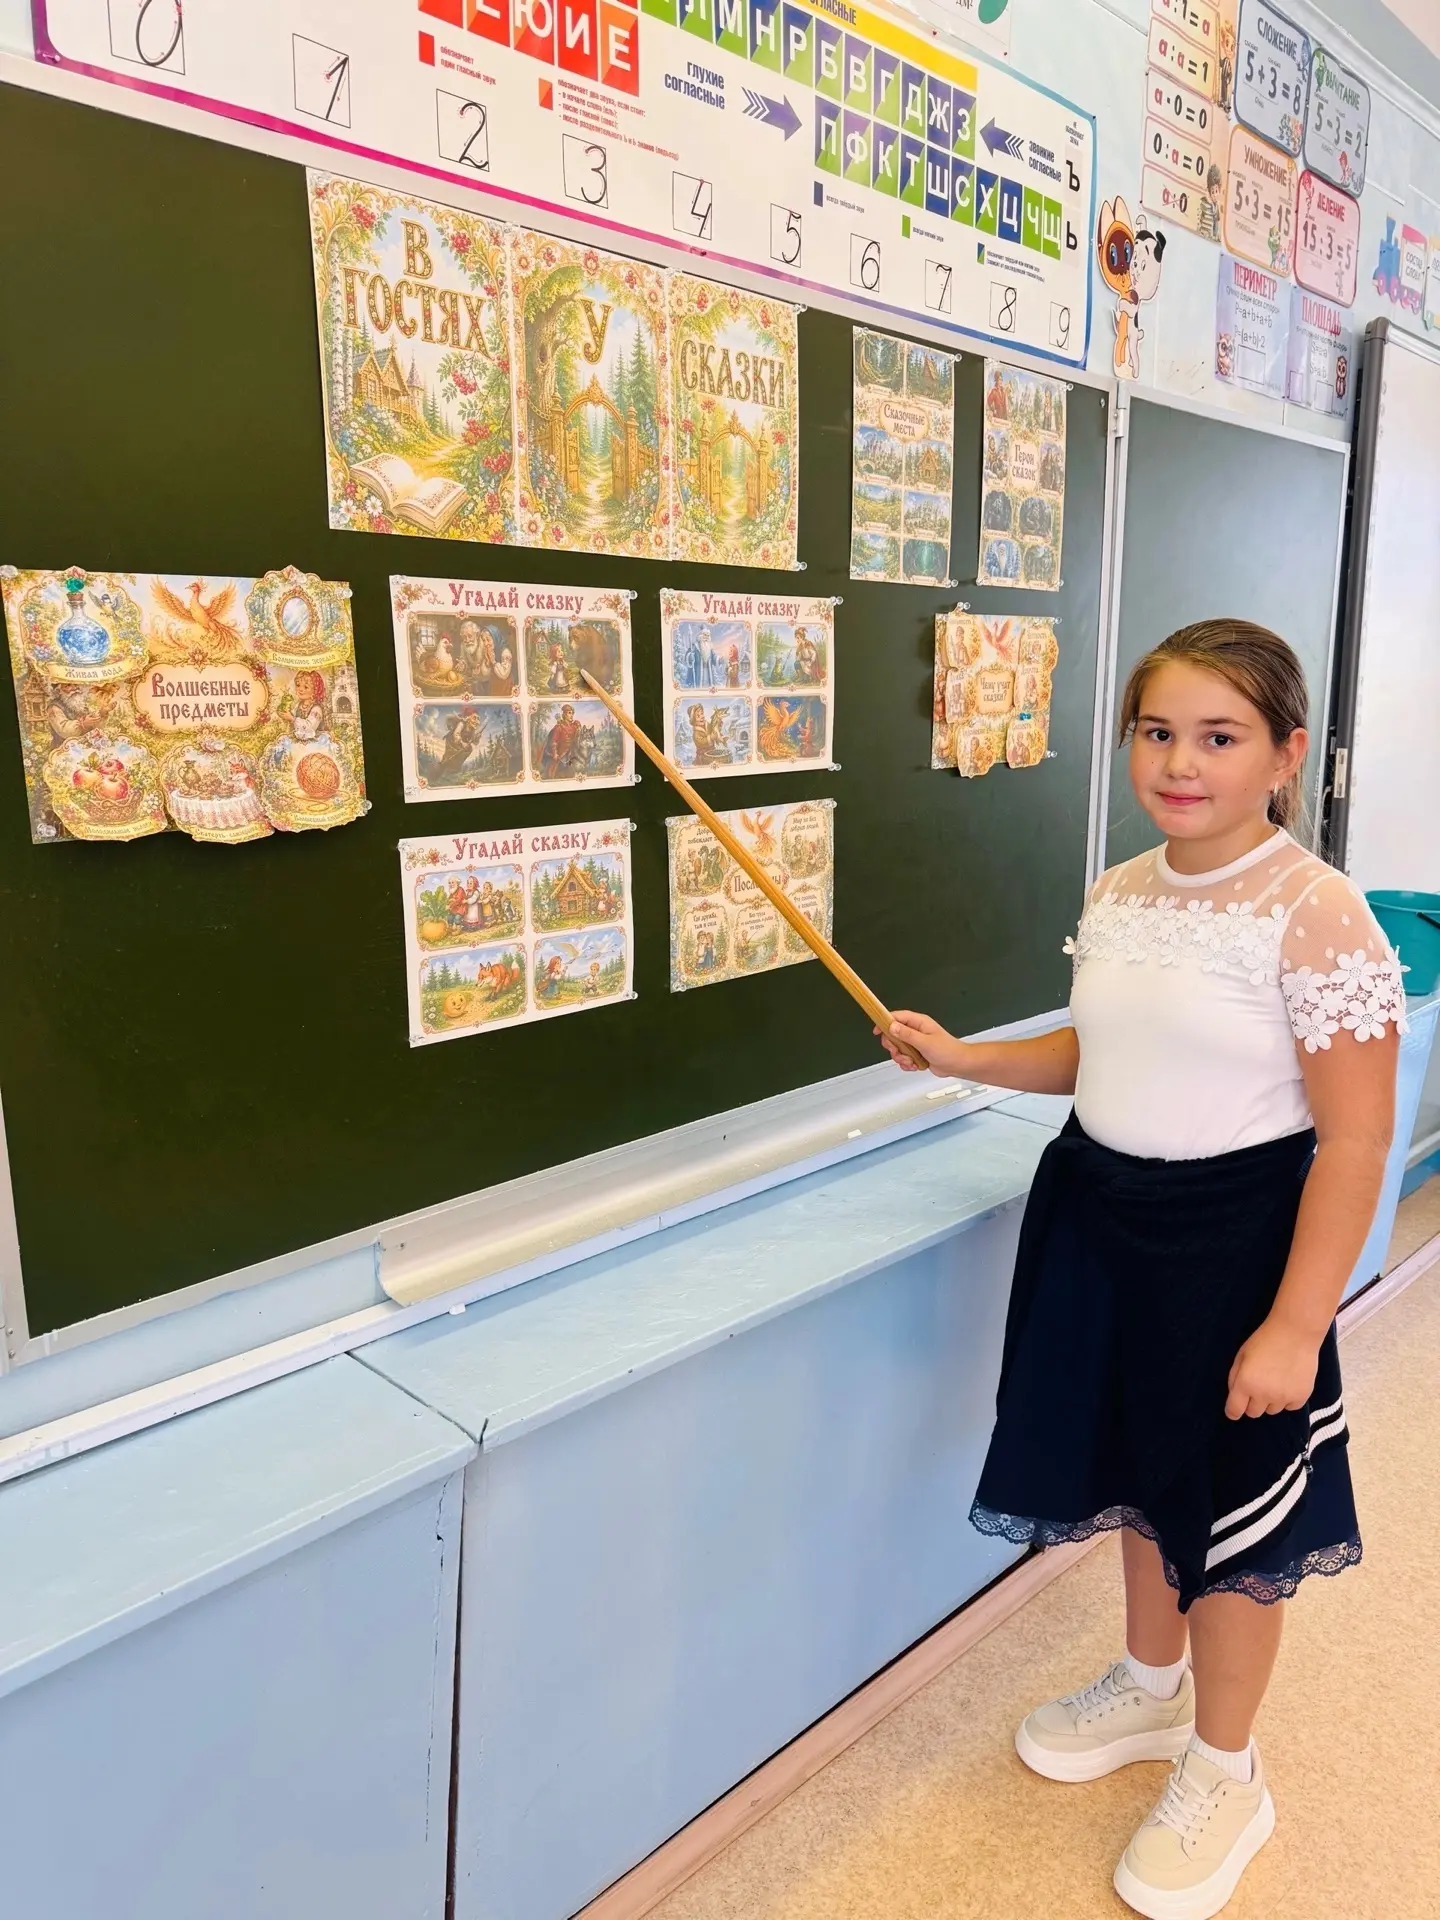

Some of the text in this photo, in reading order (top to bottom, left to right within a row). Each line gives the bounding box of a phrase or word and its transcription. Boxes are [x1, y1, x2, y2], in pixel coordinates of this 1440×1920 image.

[136, 0, 183, 66] 0
[810, 0, 856, 26] ЛАСНЫЕ
[515, 0, 552, 38] Ю
[565, 6, 591, 56] И
[609, 24, 631, 71] Е
[1257, 17, 1298, 61] СЛОЖЕНИЕ
[325, 55, 349, 120] 1
[664, 73, 725, 110] согласные
[687, 61, 724, 90] глухие
[719, 0, 743, 38] М
[756, 8, 775, 52] Н
[789, 24, 807, 62] Р
[821, 40, 838, 80] Б
[850, 54, 867, 93] В
[881, 69, 894, 103] Г
[905, 82, 923, 127] Д
[929, 94, 950, 133] Ж
[957, 108, 971, 141] З
[1203, 62, 1208, 83] 1
[1245, 50, 1255, 82] 5
[1268, 66, 1277, 98] 3
[1293, 84, 1301, 115] 8
[1325, 68, 1360, 111] ВЫЧИТАНИЕ
[459, 102, 488, 168] 2
[1315, 101, 1324, 131] 5
[1334, 116, 1341, 145] 3
[1355, 131, 1362, 159] 2
[1028, 156, 1061, 183] согласные
[1029, 141, 1055, 163] звонкие
[1244, 144, 1287, 187] УМНОЖЕНИЕ
[582, 145, 608, 204] 3
[821, 115, 1061, 251] П Ф К Т Ш С Х Ц Ч Щ
[1065, 159, 1080, 192] Ъ
[691, 180, 712, 237] 4
[1234, 180, 1243, 211] 5
[1251, 189, 1259, 220] 3
[1277, 204, 1291, 237] 15
[1317, 191, 1345, 222] ДЕЛЕНИЕ
[401, 218, 432, 279] В
[782, 211, 801, 263] 5
[1066, 220, 1078, 251] Ь
[1303, 221, 1317, 251] 15
[1326, 232, 1333, 260] 3
[861, 241, 880, 290] 6
[1234, 262, 1277, 301] ПЕРИМЕТР
[936, 264, 952, 311] 7
[998, 287, 1016, 331] 8
[342, 266, 491, 359] ГОСТЯХ
[580, 298, 613, 364] У
[1057, 307, 1070, 347] 9
[1302, 295, 1342, 338] ПЛОЩАДЬ
[680, 339, 786, 409] СКАЗКИ
[884, 404, 925, 425] Сказочные
[893, 423, 915, 437] места
[1012, 466, 1036, 481] сказок
[449, 583, 584, 614] Угадай сказку
[702, 594, 801, 619] Угадай сказку
[65, 666, 123, 678] Живая вода
[152, 672, 250, 697] Волшебные
[160, 702, 249, 725] предметы
[452, 831, 591, 860] Угадай сказку
[734, 875, 781, 892] Послы
